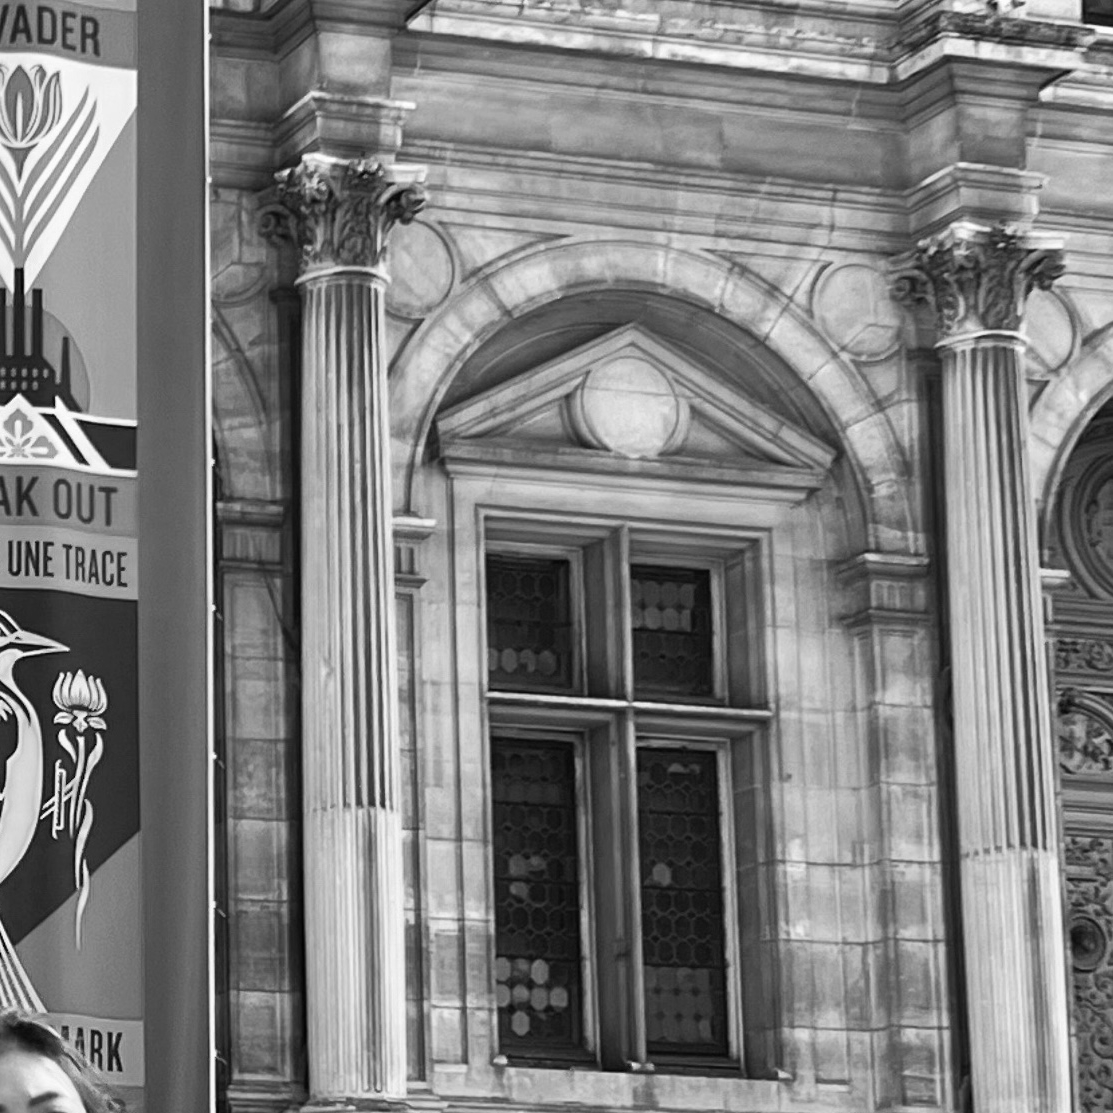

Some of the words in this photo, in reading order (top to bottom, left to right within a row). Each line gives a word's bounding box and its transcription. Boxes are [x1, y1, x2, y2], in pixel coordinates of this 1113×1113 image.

[53, 478, 118, 527] OUT
[7, 540, 55, 578] UNE
[62, 543, 128, 588] TRACE
